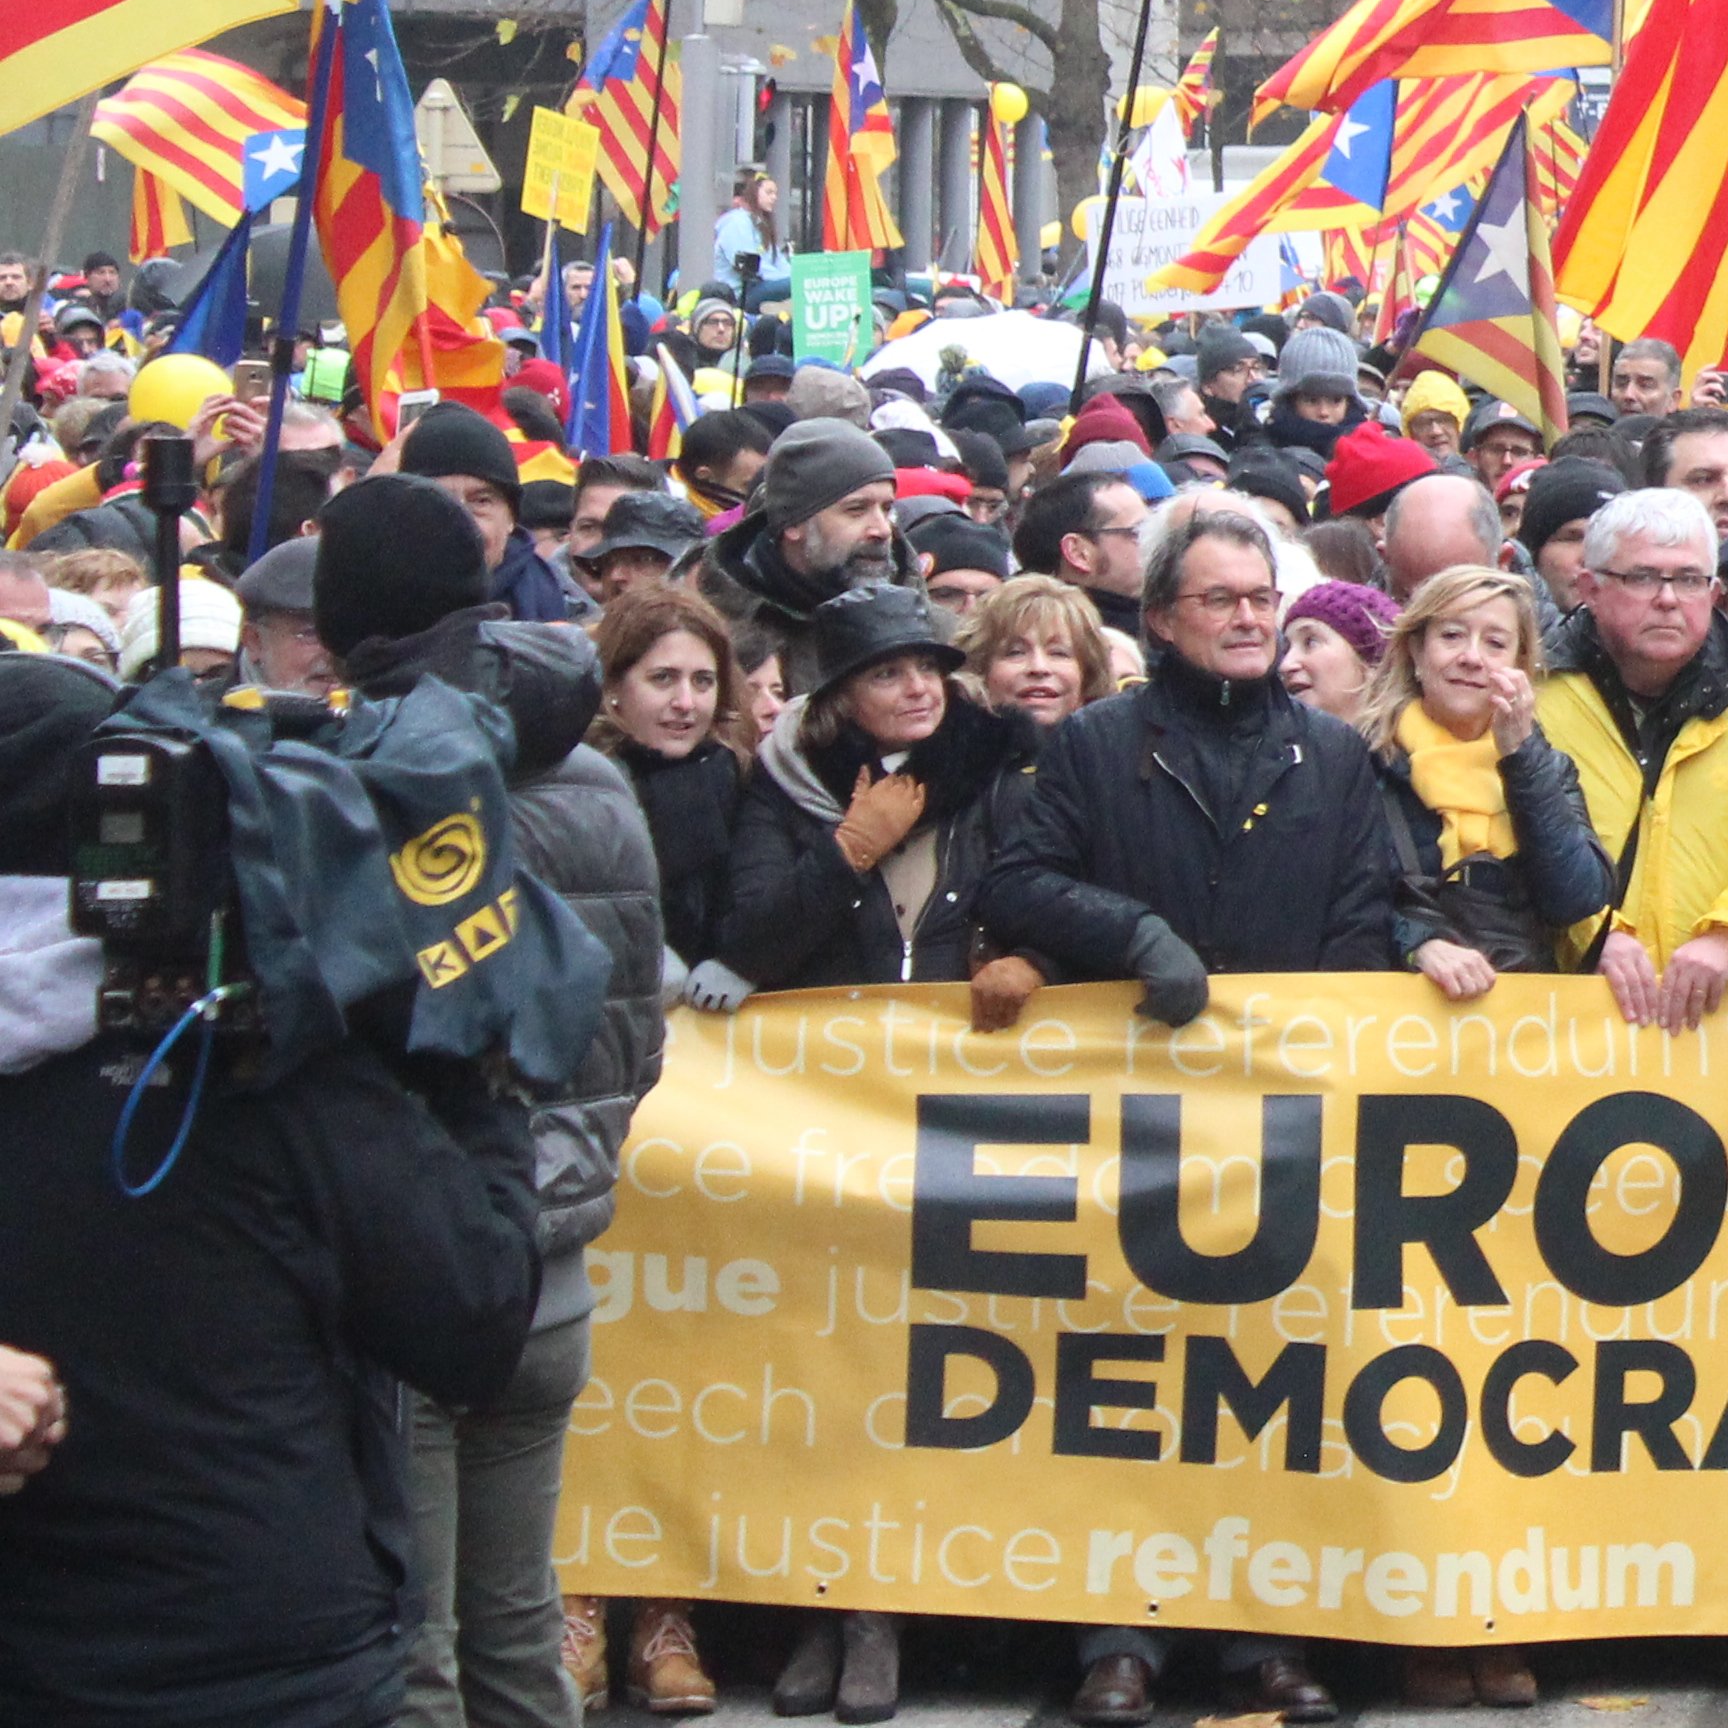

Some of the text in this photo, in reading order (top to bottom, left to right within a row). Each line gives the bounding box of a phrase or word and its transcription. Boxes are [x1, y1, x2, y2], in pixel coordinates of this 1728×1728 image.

[804, 275, 857, 289] EUROPE
[804, 287, 857, 304] WAKE
[566, 1363, 816, 1447] eech
[698, 1492, 1063, 1592] justice
[1085, 1515, 1695, 1620] referendum
